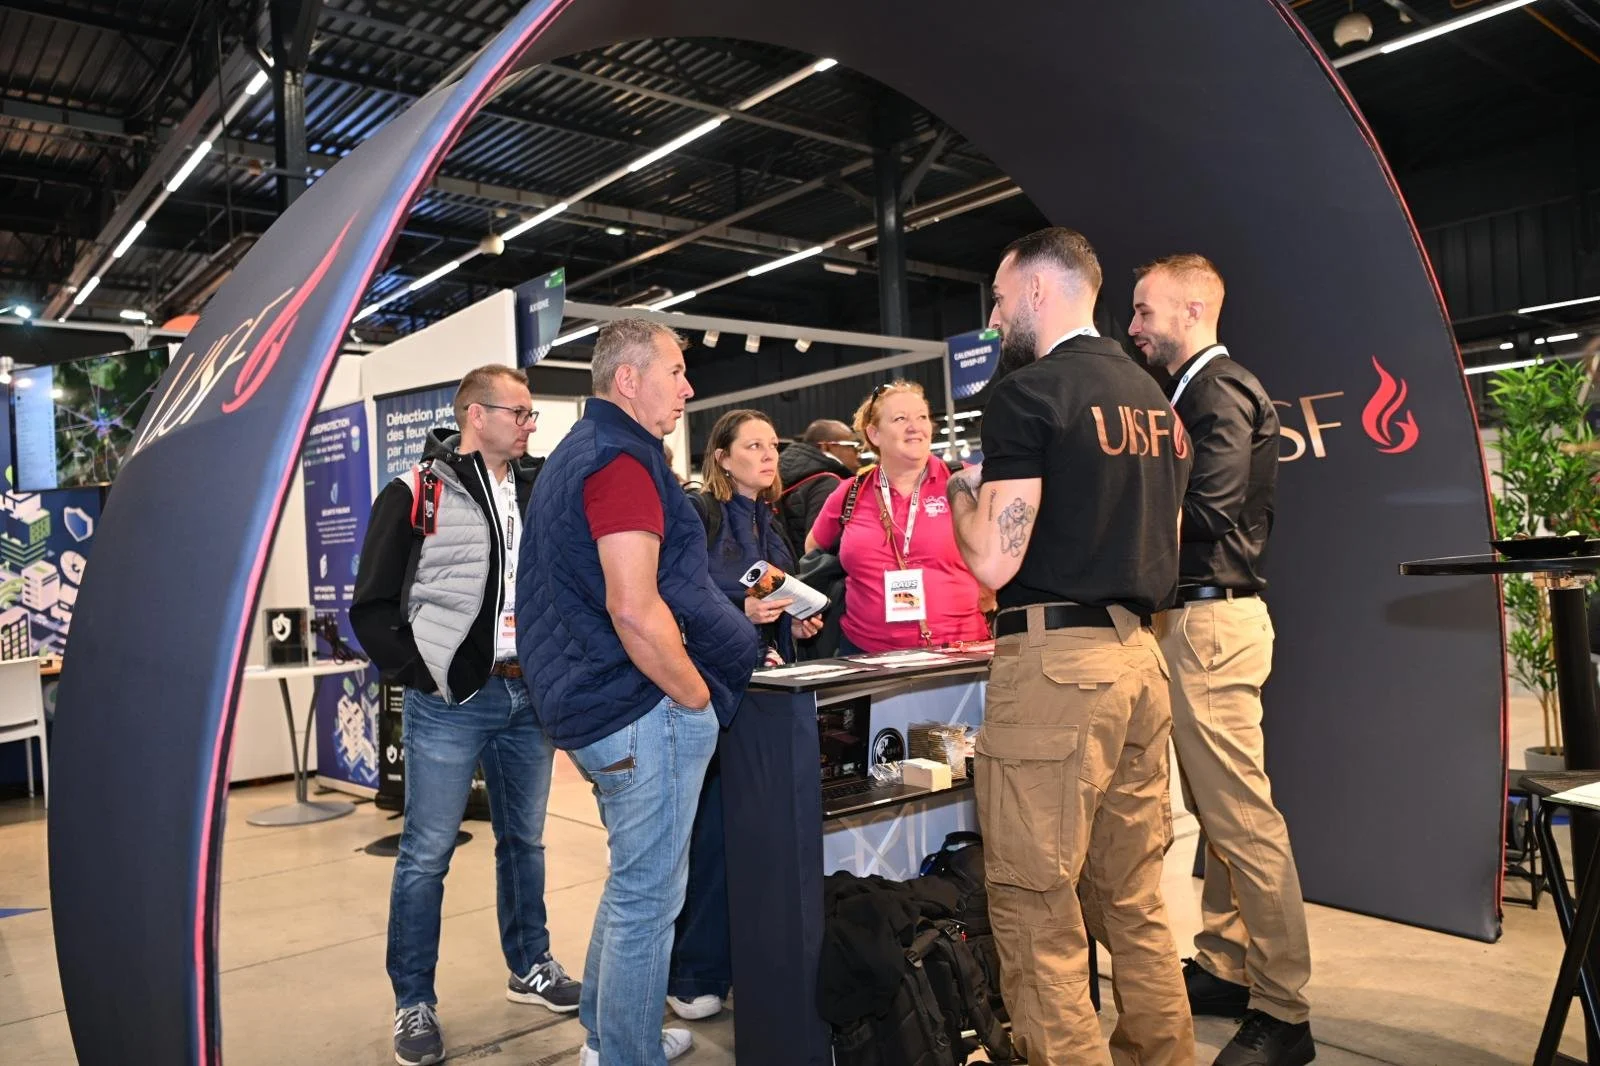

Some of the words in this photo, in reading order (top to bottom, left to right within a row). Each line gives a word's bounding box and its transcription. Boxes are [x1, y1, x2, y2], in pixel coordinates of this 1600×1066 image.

[386, 409, 434, 427] Détection
[1271, 392, 1344, 462] SF
[386, 429, 404, 442] des
[406, 426, 427, 439] feux
[1091, 405, 1169, 457] UISF
[386, 446, 402, 460] par
